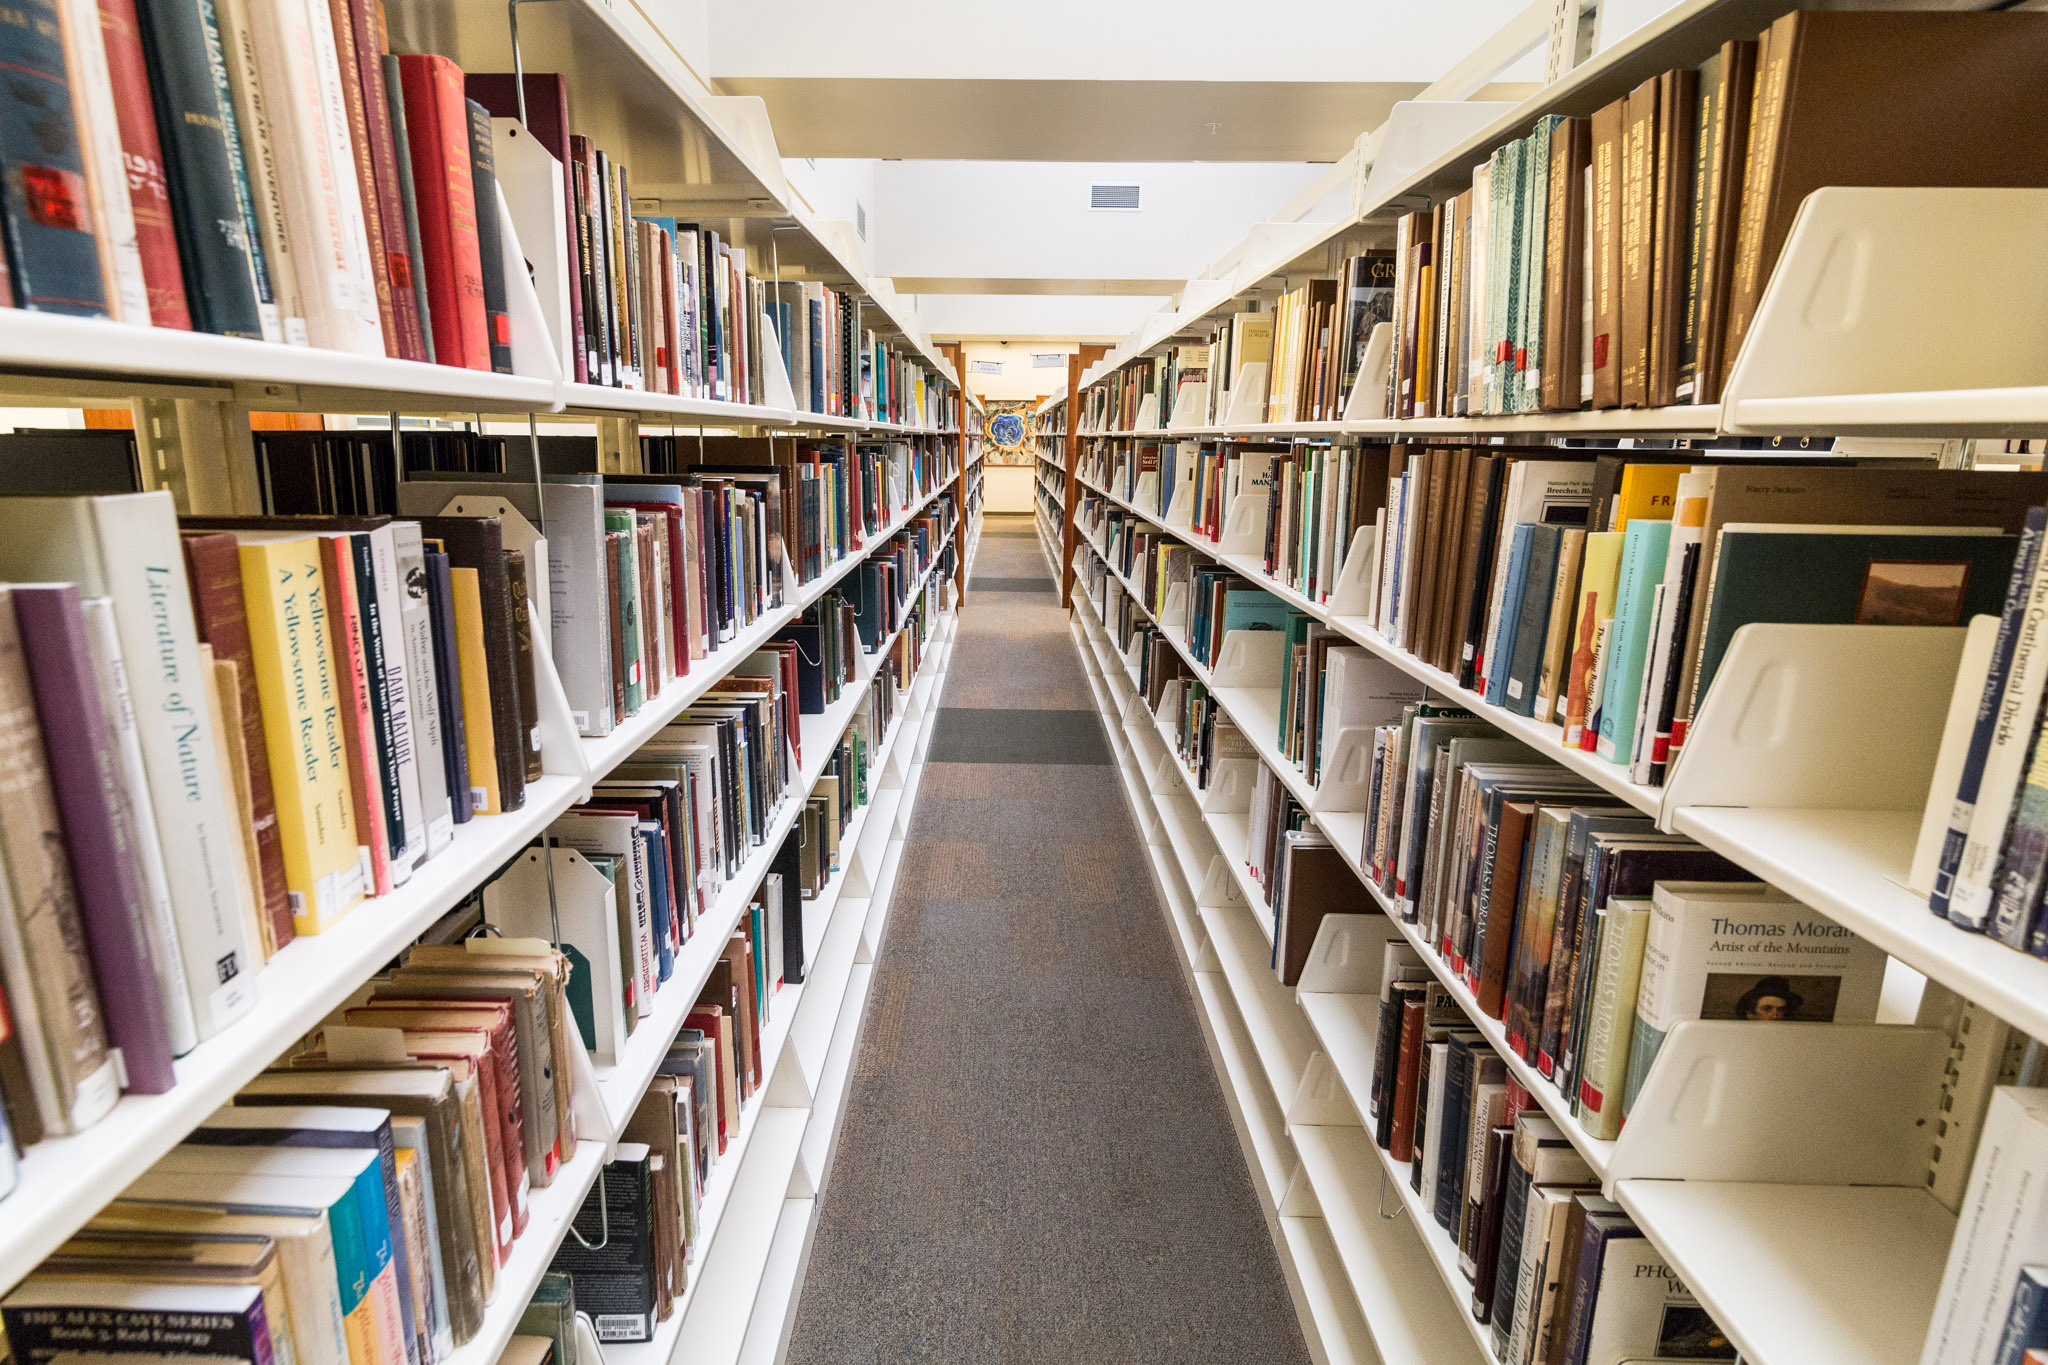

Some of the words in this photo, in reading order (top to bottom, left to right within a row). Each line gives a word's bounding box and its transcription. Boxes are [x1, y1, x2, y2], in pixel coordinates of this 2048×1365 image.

[339, 0, 355, 57] ECORDS
[347, 61, 358, 80] OF
[351, 85, 366, 134] NORTH
[1701, 95, 1710, 126] NATIONAL
[241, 30, 257, 87] GREAT
[253, 94, 266, 138] BEAR
[262, 148, 287, 253] ADVENTURES
[1699, 127, 1708, 159] REGISTER
[358, 138, 376, 209] AMERICAN
[1696, 170, 1704, 200] HISTORIC
[369, 213, 380, 235] BIG
[580, 214, 588, 246] BUFFALO
[1694, 201, 1702, 225] PLACES
[373, 240, 386, 273] GAME
[1691, 226, 1700, 265] NOMINATION
[595, 244, 603, 300] HISTORY
[1601, 244, 1609, 289] QUARTERMASTER
[1688, 267, 1696, 296] MULTIPLE
[1546, 487, 1580, 495] Breeches,
[2012, 528, 2034, 567] Along
[279, 567, 294, 586] A
[303, 562, 318, 580] A
[2006, 574, 2023, 595] the
[146, 566, 180, 683] Literature
[369, 603, 377, 615] In
[370, 618, 379, 634] the
[308, 586, 332, 702] Yellowstone
[418, 620, 428, 654] Wolves
[1596, 627, 1604, 640] The
[1987, 598, 2017, 675] Continental
[2008, 607, 2039, 694] Continental
[282, 593, 308, 711] Yellowstone
[349, 613, 361, 655] RING
[357, 683, 369, 715] FIRE
[372, 636, 383, 666] Work
[411, 636, 420, 676] American
[1590, 642, 1601, 672] Antique
[377, 668, 385, 678] of
[385, 666, 404, 705] DARK
[1587, 674, 1597, 695] Bottle
[161, 693, 195, 717] of
[378, 680, 389, 709] Their
[425, 691, 435, 716] Wolf
[323, 706, 341, 770] Reader
[382, 711, 393, 745] Hands
[390, 710, 411, 766] NATURE
[426, 720, 438, 745] Myth
[172, 723, 202, 802] Nature
[300, 716, 317, 784] Reader
[387, 756, 398, 785] Their
[390, 788, 402, 821] Prayer
[1481, 823, 1498, 883] THOMAS
[1559, 872, 1572, 907] Drawn
[1475, 885, 1491, 938] MORAN
[1576, 896, 1588, 931] Drawn
[1711, 917, 1786, 937] Thomas
[1600, 923, 1625, 998] THOMAS
[1709, 940, 1745, 953] Artist
[1747, 940, 1762, 953] of
[1764, 942, 1783, 954] the
[1787, 942, 1850, 955] Mountains
[1567, 951, 1581, 1009] Yellowstone
[1591, 999, 1615, 1069] MORAN
[1472, 1115, 1481, 1160] MONTANA
[1475, 1100, 1488, 1184] PHOTOGRAPHING
